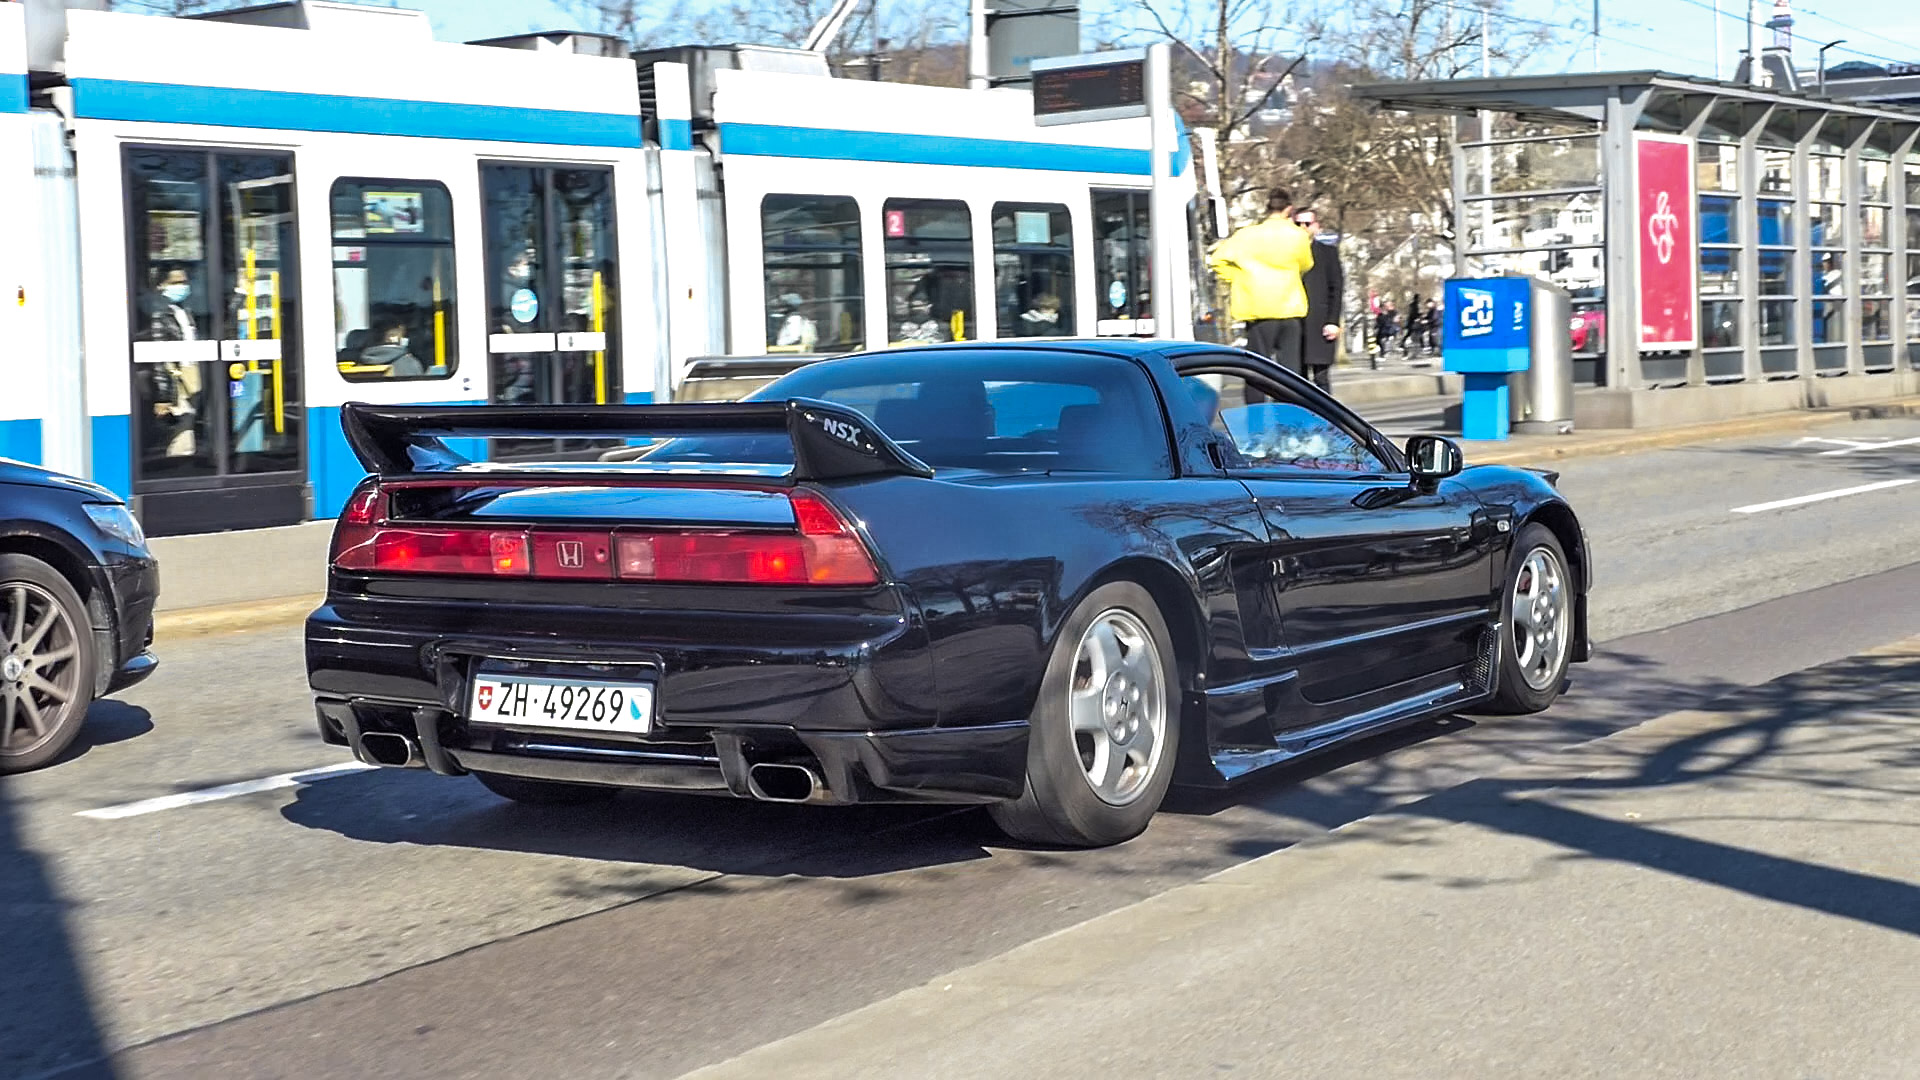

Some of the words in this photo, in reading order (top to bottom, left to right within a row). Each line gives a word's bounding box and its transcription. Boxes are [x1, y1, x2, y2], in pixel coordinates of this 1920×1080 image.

[888, 214, 901, 233] 2
[1460, 291, 1494, 327] 20
[823, 417, 861, 447] NSX
